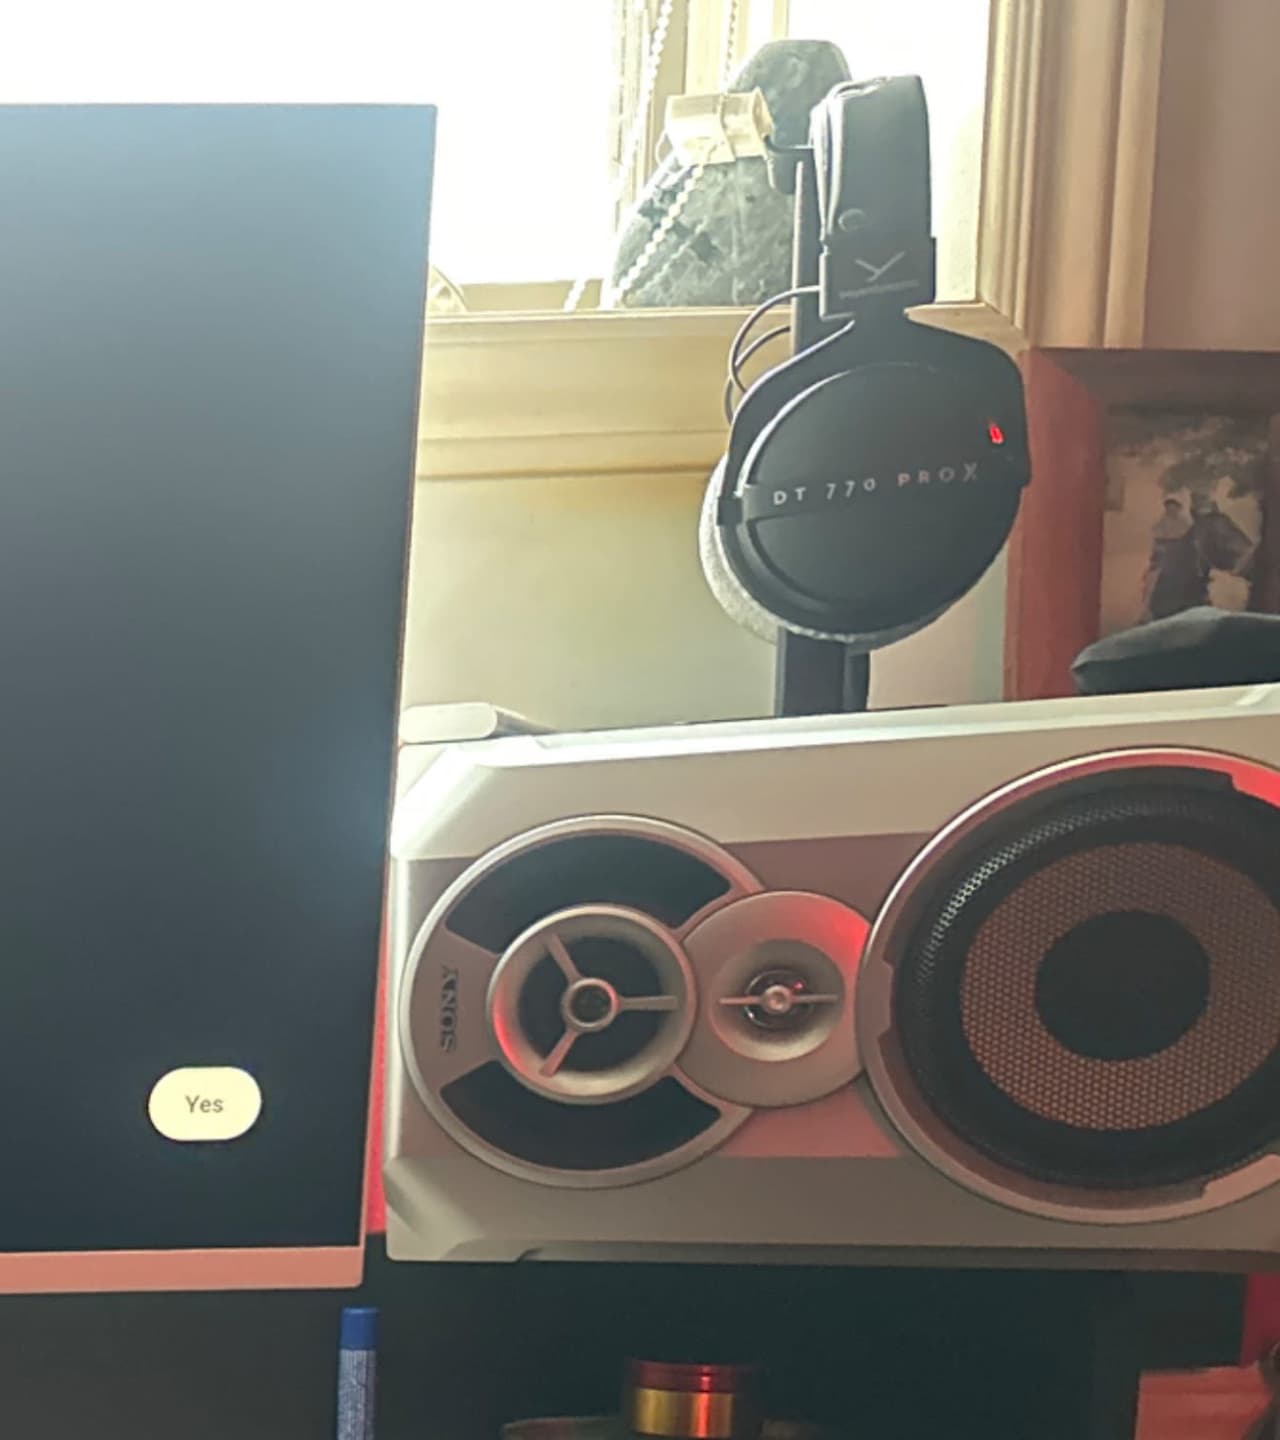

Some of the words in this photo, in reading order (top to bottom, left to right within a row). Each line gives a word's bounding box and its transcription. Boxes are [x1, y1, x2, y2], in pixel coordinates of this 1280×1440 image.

[773, 486, 806, 506] DT
[825, 477, 877, 500] 770
[439, 965, 459, 1053] SONY
[185, 1095, 225, 1114] Yes
